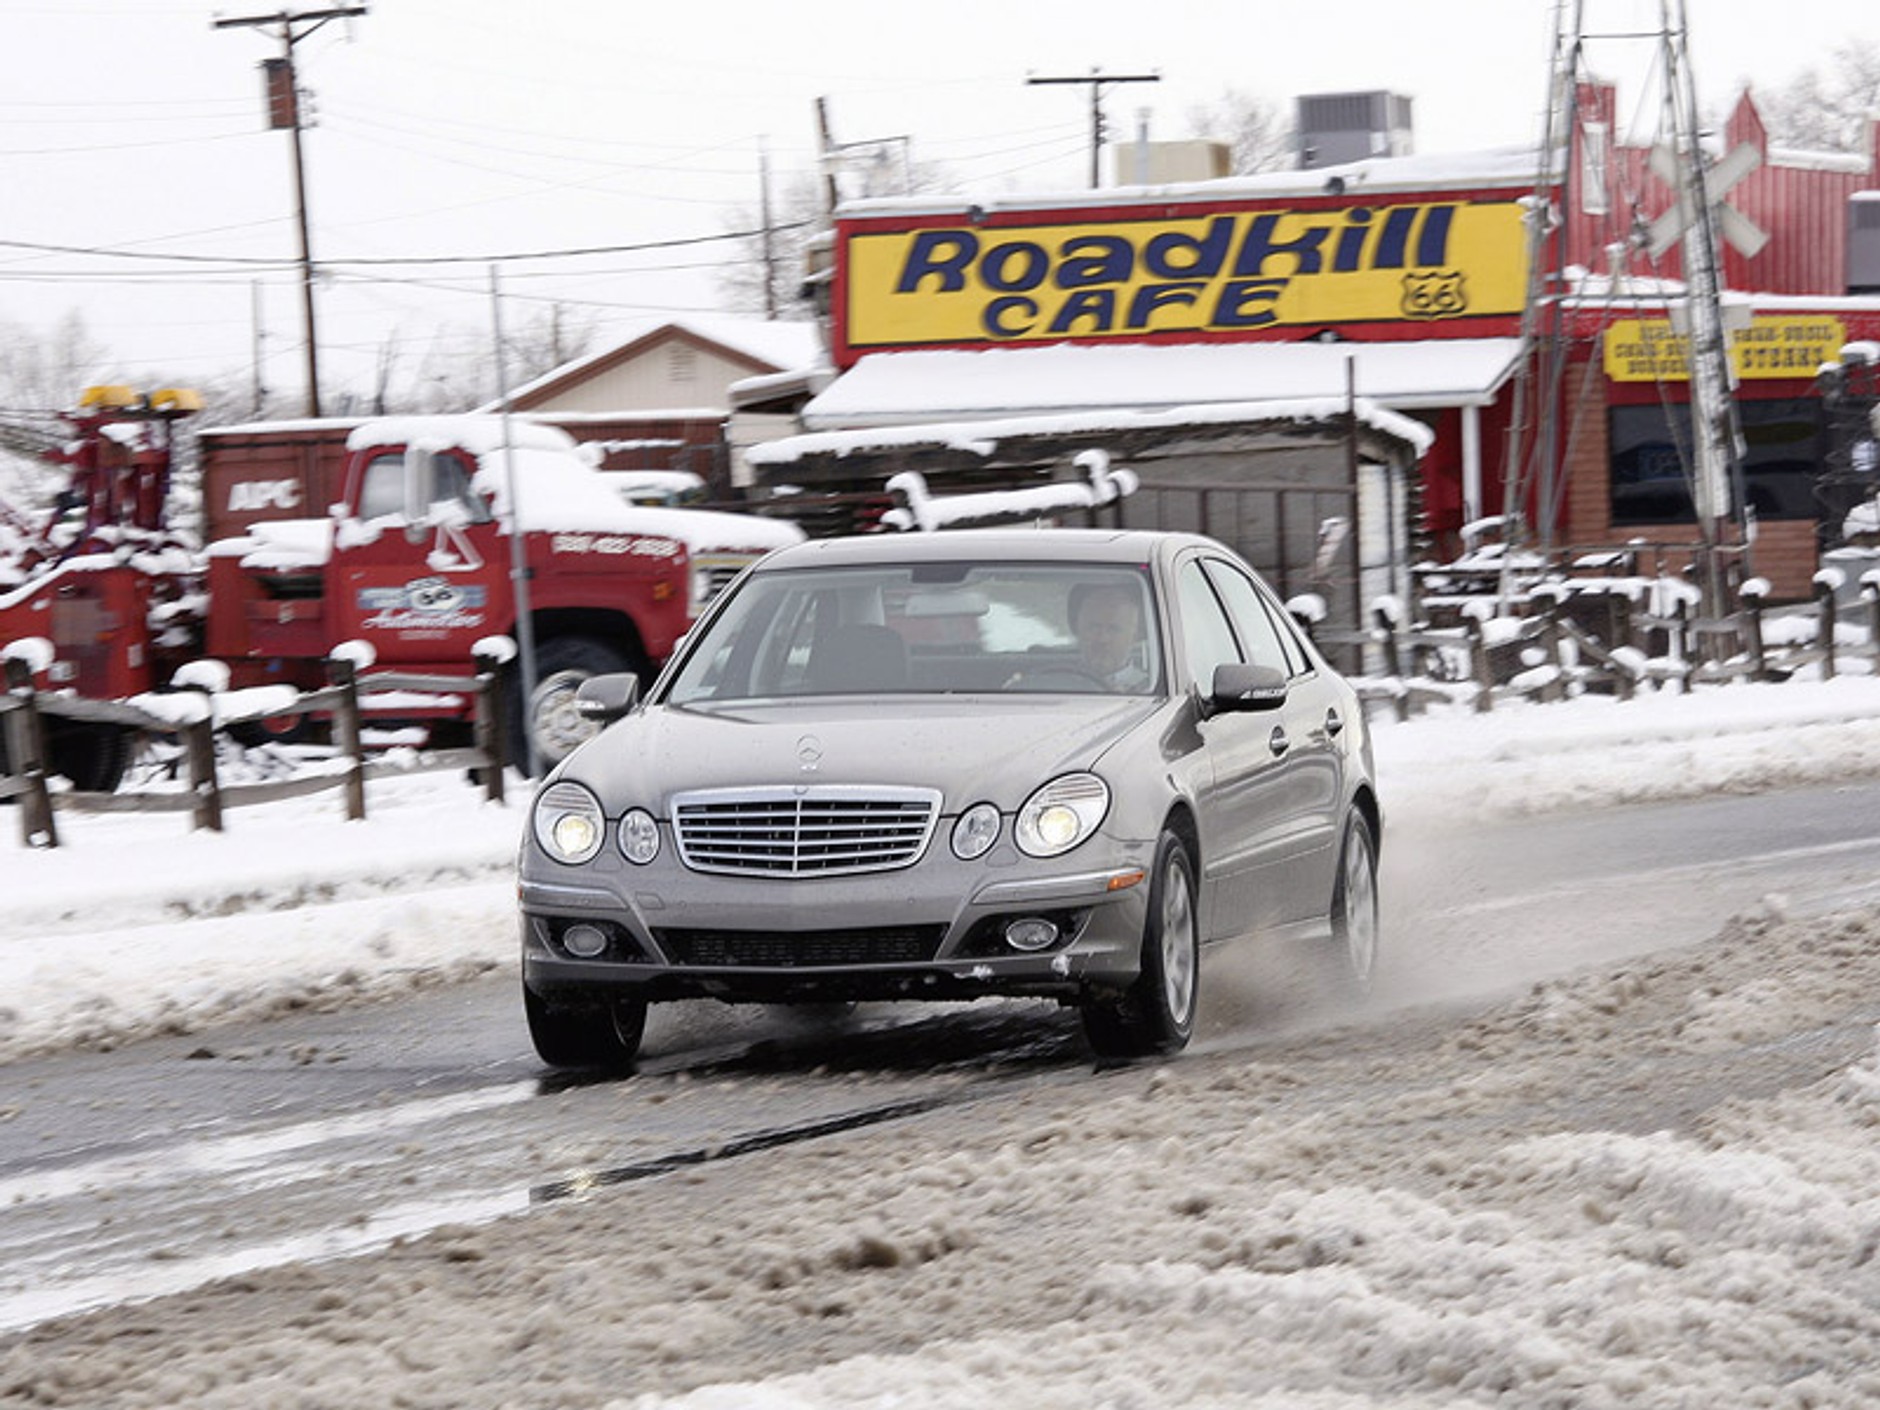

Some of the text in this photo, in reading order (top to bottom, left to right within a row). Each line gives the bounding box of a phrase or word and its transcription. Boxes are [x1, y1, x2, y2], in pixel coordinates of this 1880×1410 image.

[894, 204, 1454, 293] Roadkill
[984, 278, 1290, 336] CAFE
[1411, 284, 1456, 308] 66
